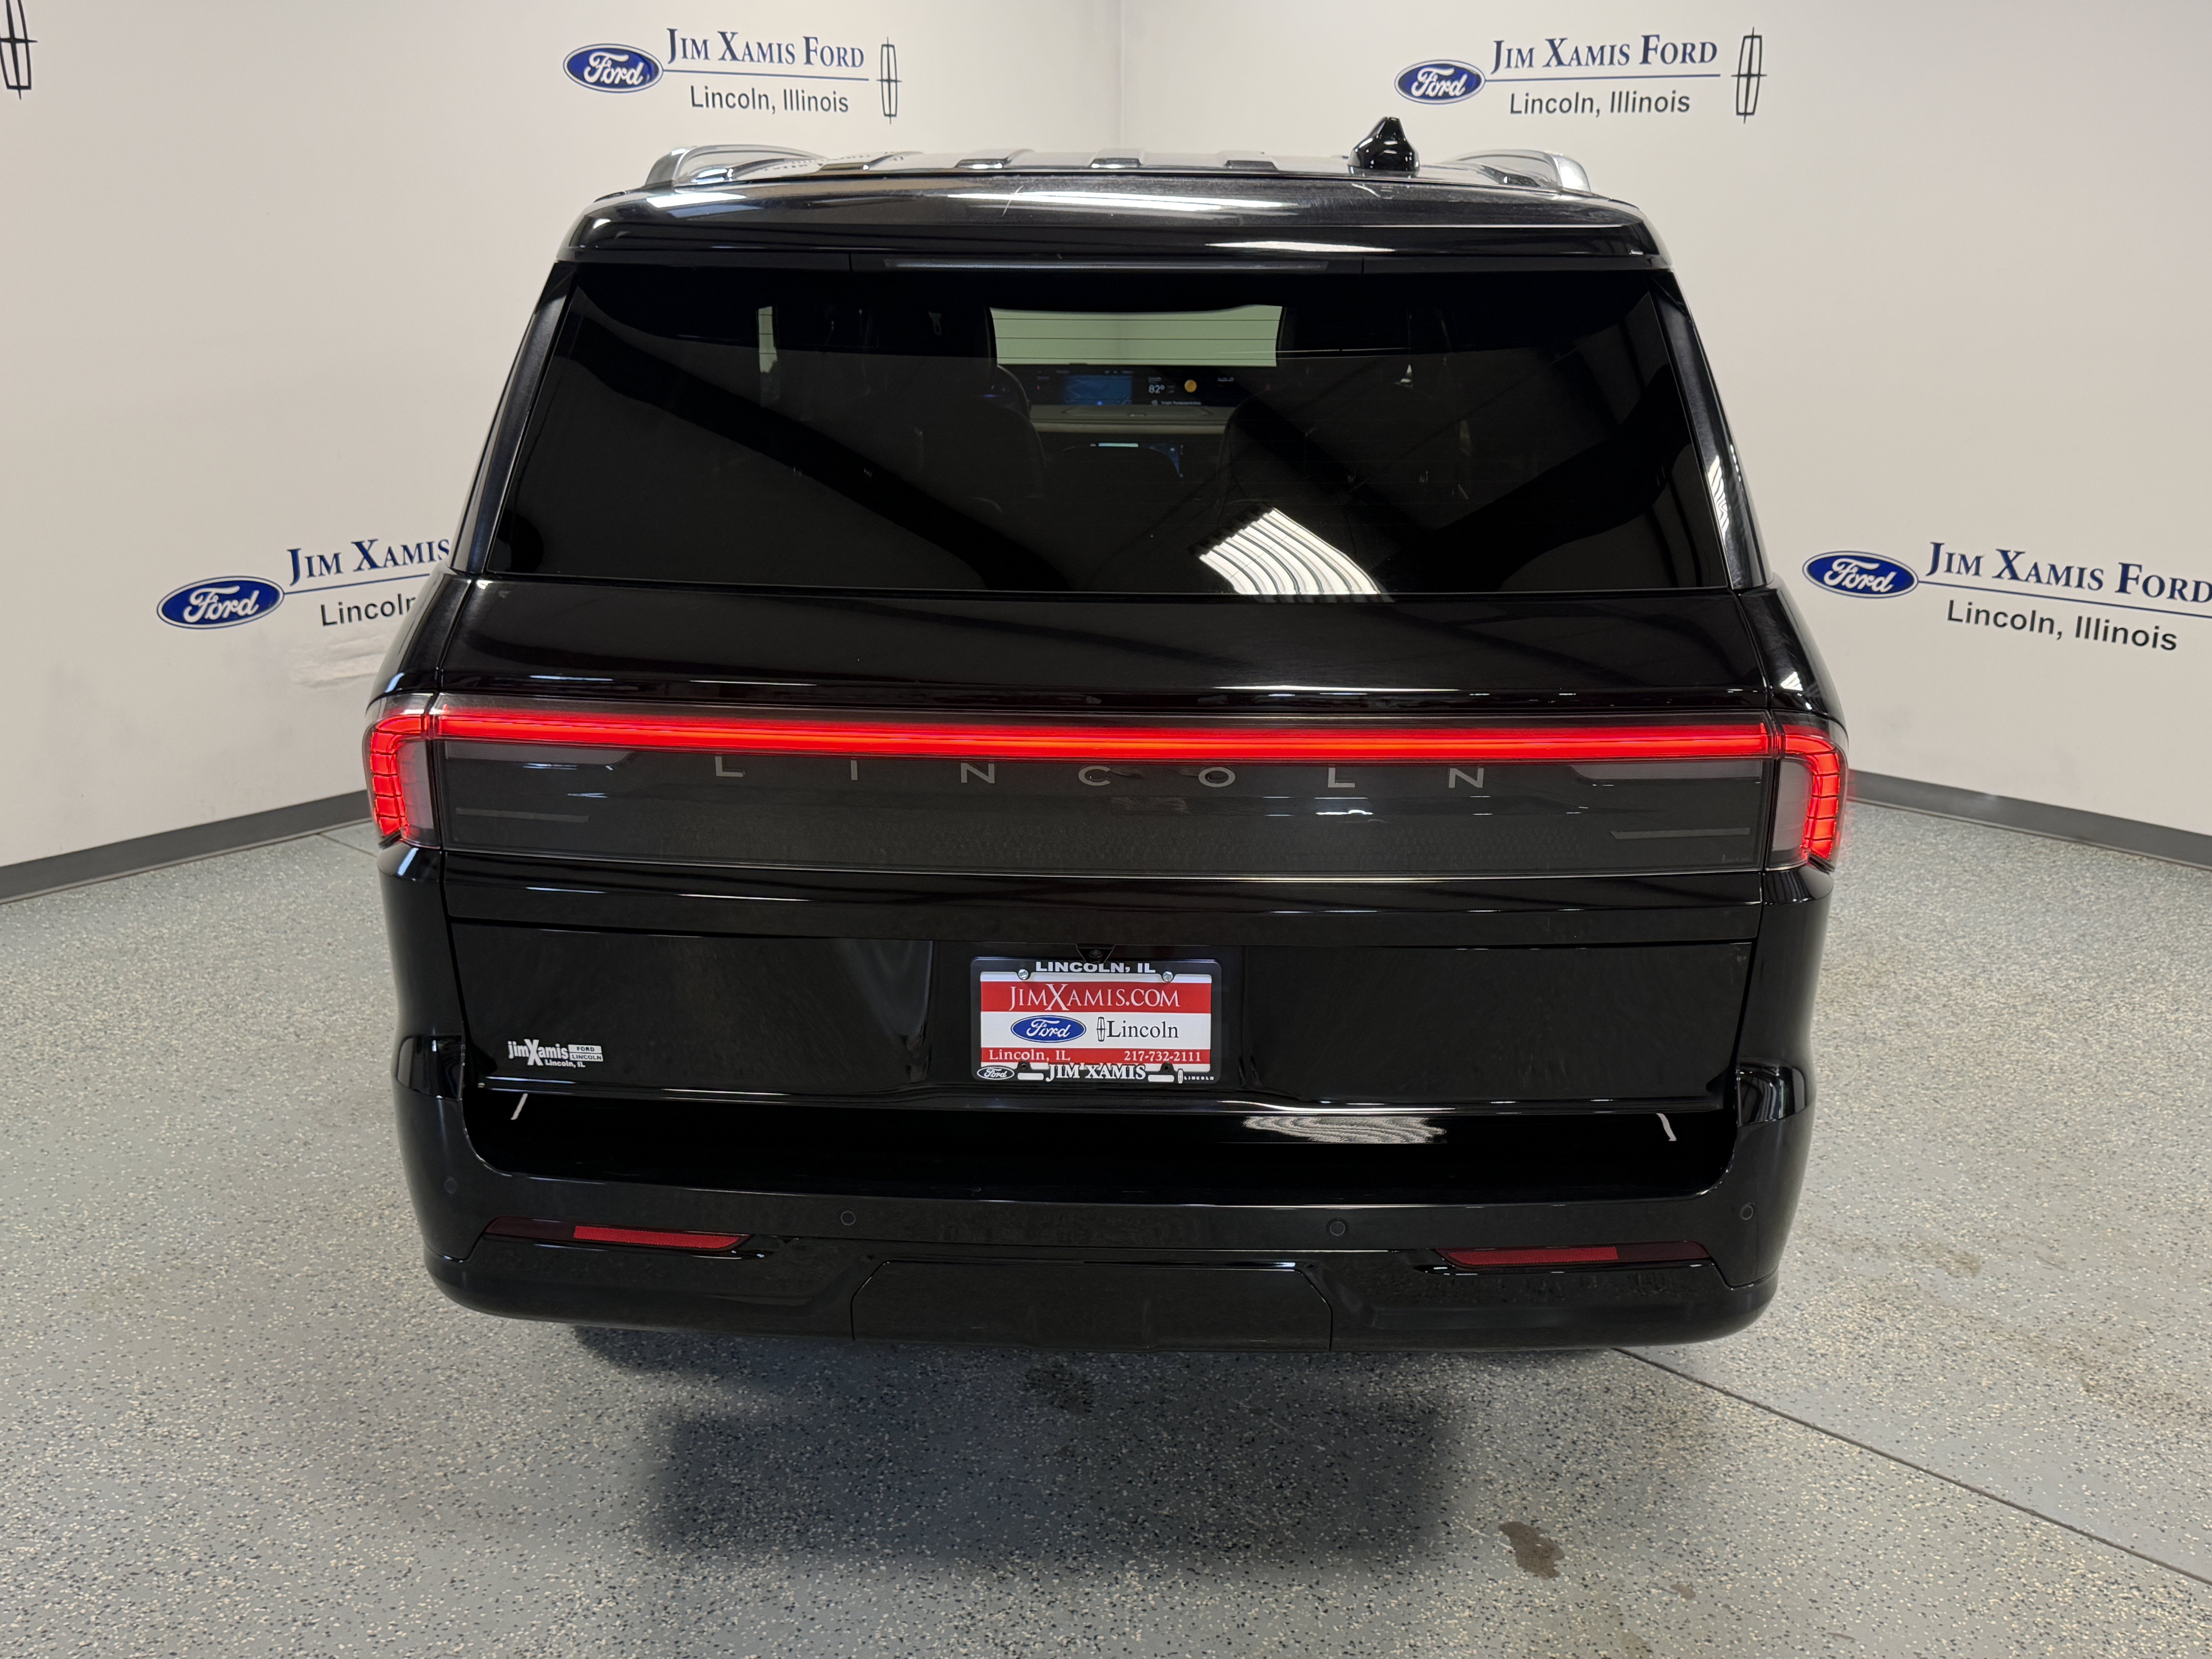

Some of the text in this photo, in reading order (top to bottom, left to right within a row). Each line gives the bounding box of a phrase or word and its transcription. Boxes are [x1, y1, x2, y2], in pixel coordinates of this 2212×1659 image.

[584, 52, 644, 85] Ford
[1411, 67, 1467, 97] Ford
[691, 86, 848, 114] Lincoln, Illinois
[1510, 90, 1690, 117] Lincoln, Illinois
[1824, 558, 1896, 593] Ford
[183, 586, 259, 623] Ford
[1947, 599, 2178, 651] Lincoln, Illinois
[716, 756, 1484, 788] LINCOLN
[1036, 962, 1156, 973] LINCOLN, IL
[1026, 1019, 1071, 1037] Ford
[1107, 1020, 1179, 1038] Lincoln
[544, 1059, 576, 1068] Lincoln,
[989, 1049, 1070, 1061] Lincoln, IL
[1124, 1051, 1200, 1062] 217-732-2111
[984, 1068, 1008, 1078] Ford
[1046, 1064, 1146, 1082] JIM XAMIS
